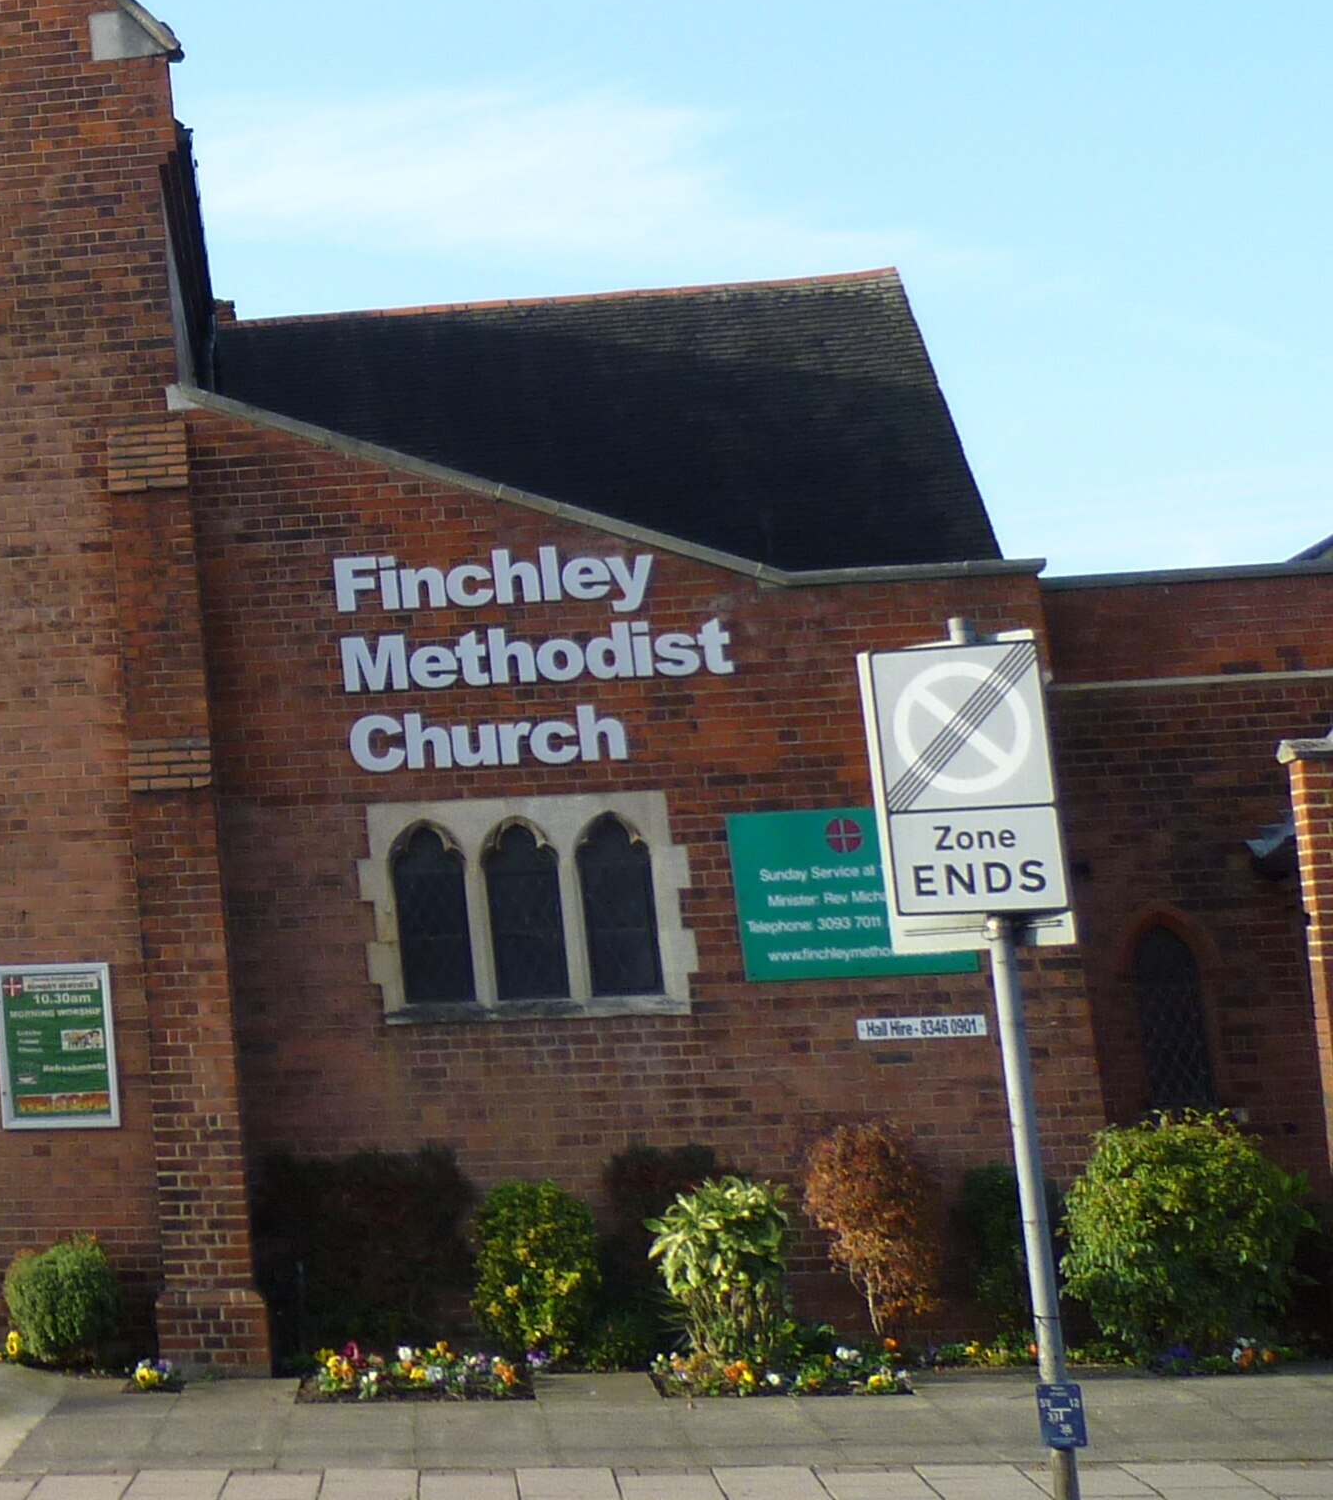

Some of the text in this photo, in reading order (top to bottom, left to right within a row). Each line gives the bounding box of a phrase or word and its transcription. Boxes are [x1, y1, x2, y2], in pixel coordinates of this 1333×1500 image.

[332, 546, 654, 613] Finchley
[339, 617, 734, 693] Methodist
[349, 704, 628, 773] Church
[933, 825, 1016, 851] Zone
[759, 868, 807, 883] Sunday
[811, 865, 859, 879] Service
[862, 865, 876, 877] at
[912, 860, 1047, 897] ENDS
[768, 893, 819, 907] Minister:
[823, 891, 848, 905] Rev
[746, 915, 881, 936] Telephone: 3093 7011
[33, 992, 91, 1005] 10.30am
[56, 1007, 102, 1017] WORSHIP
[866, 1021, 887, 1037] Hall
[889, 1020, 912, 1036] Hire
[920, 1019, 949, 1036] 8346
[950, 1018, 977, 1034] 0901
